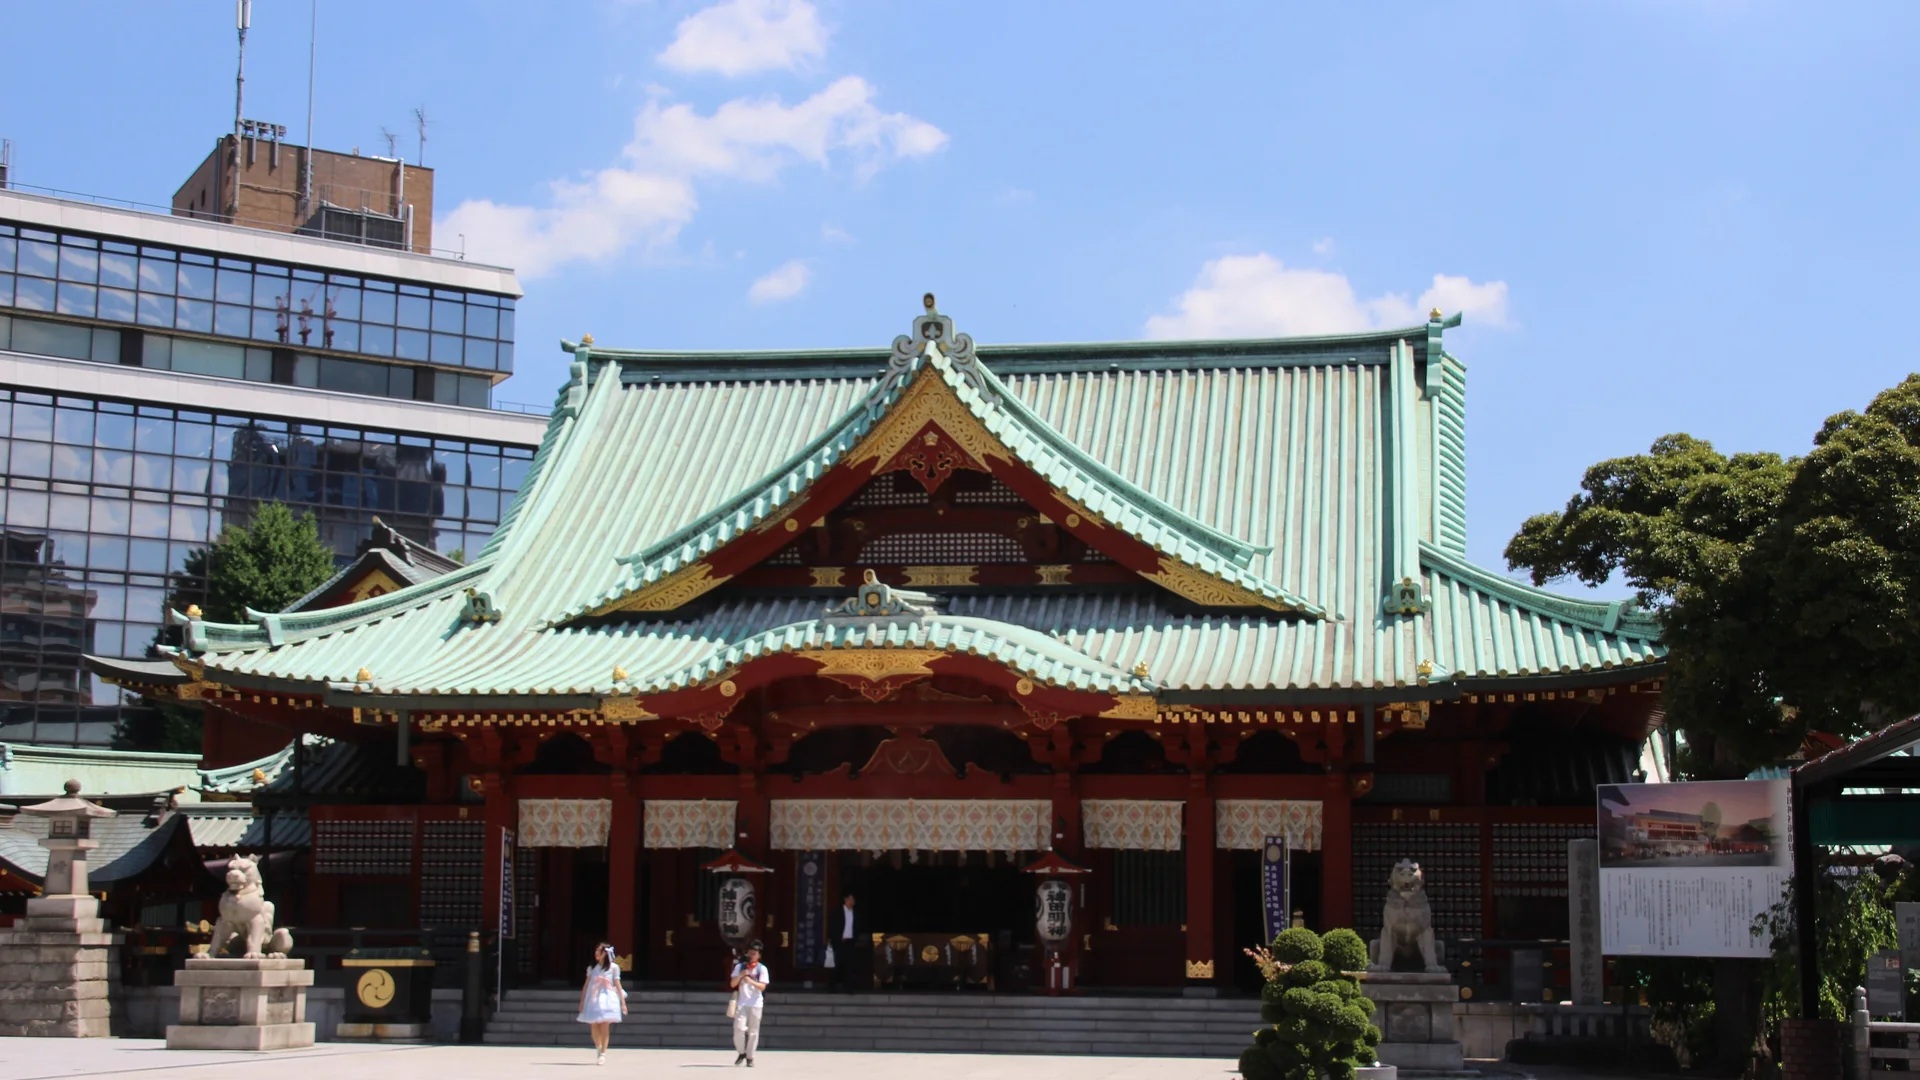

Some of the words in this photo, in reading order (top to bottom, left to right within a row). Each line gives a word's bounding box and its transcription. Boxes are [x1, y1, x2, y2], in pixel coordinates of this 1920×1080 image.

[721, 888, 739, 935] 神田明神
[1046, 890, 1066, 936] 神田明神
